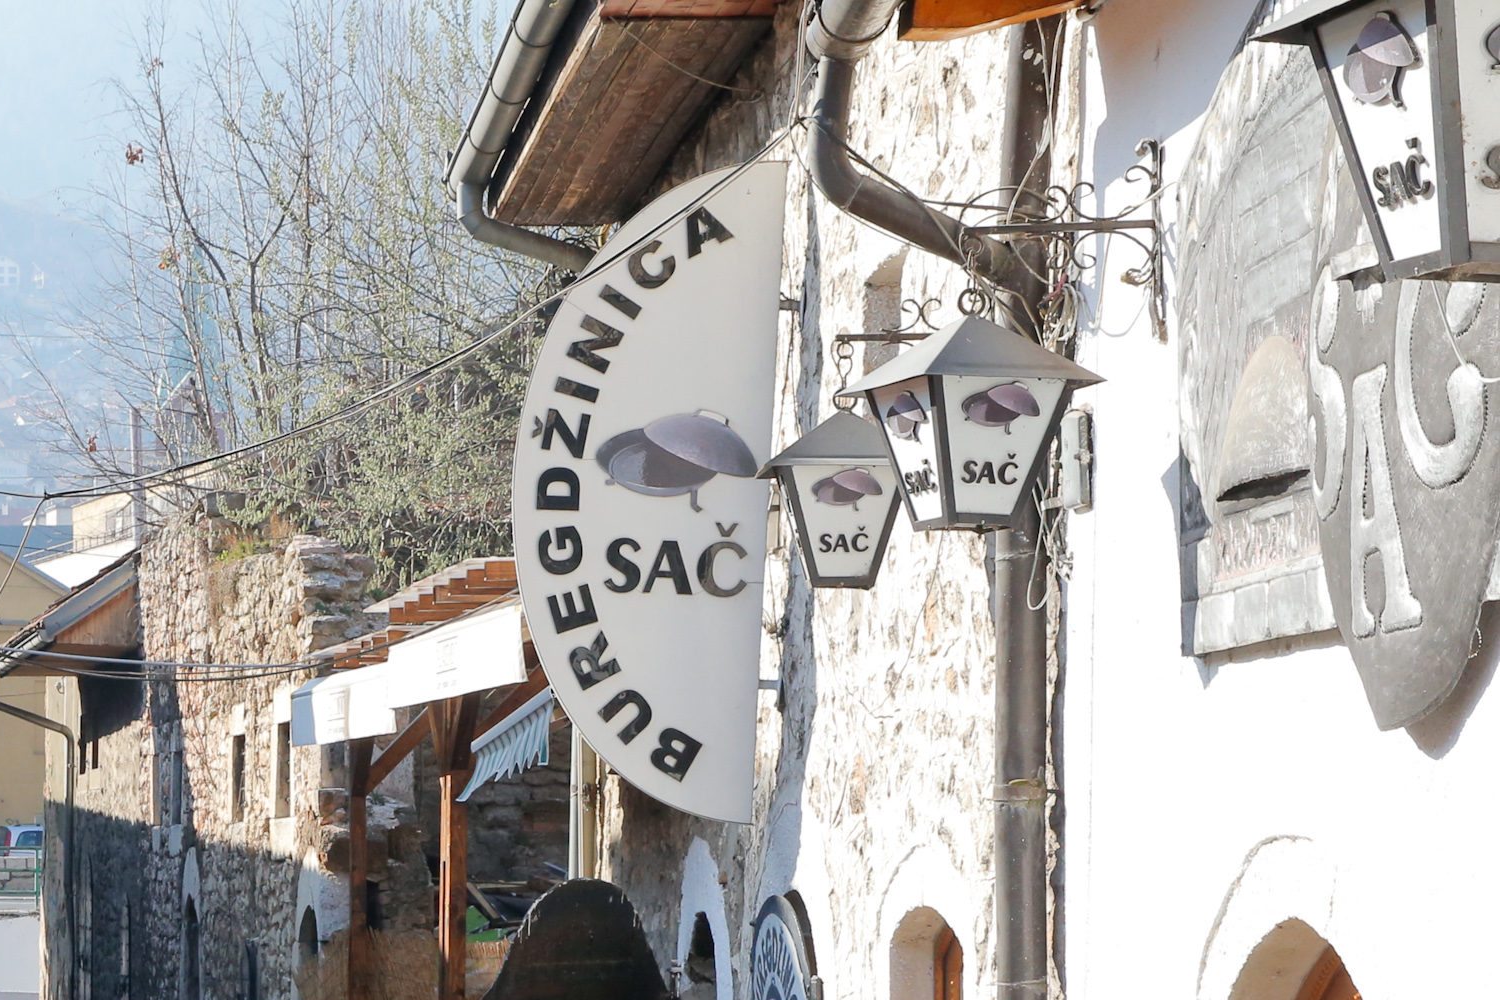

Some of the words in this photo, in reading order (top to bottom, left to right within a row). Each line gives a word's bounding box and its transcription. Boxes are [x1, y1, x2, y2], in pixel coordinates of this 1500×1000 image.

[1373, 137, 1431, 208] SAČ
[530, 206, 734, 783] BUREGDŽINICA
[905, 459, 935, 494] SAČ
[960, 453, 1018, 486] SAČ
[604, 522, 748, 598] SAČ
[818, 526, 869, 554] SAČ
